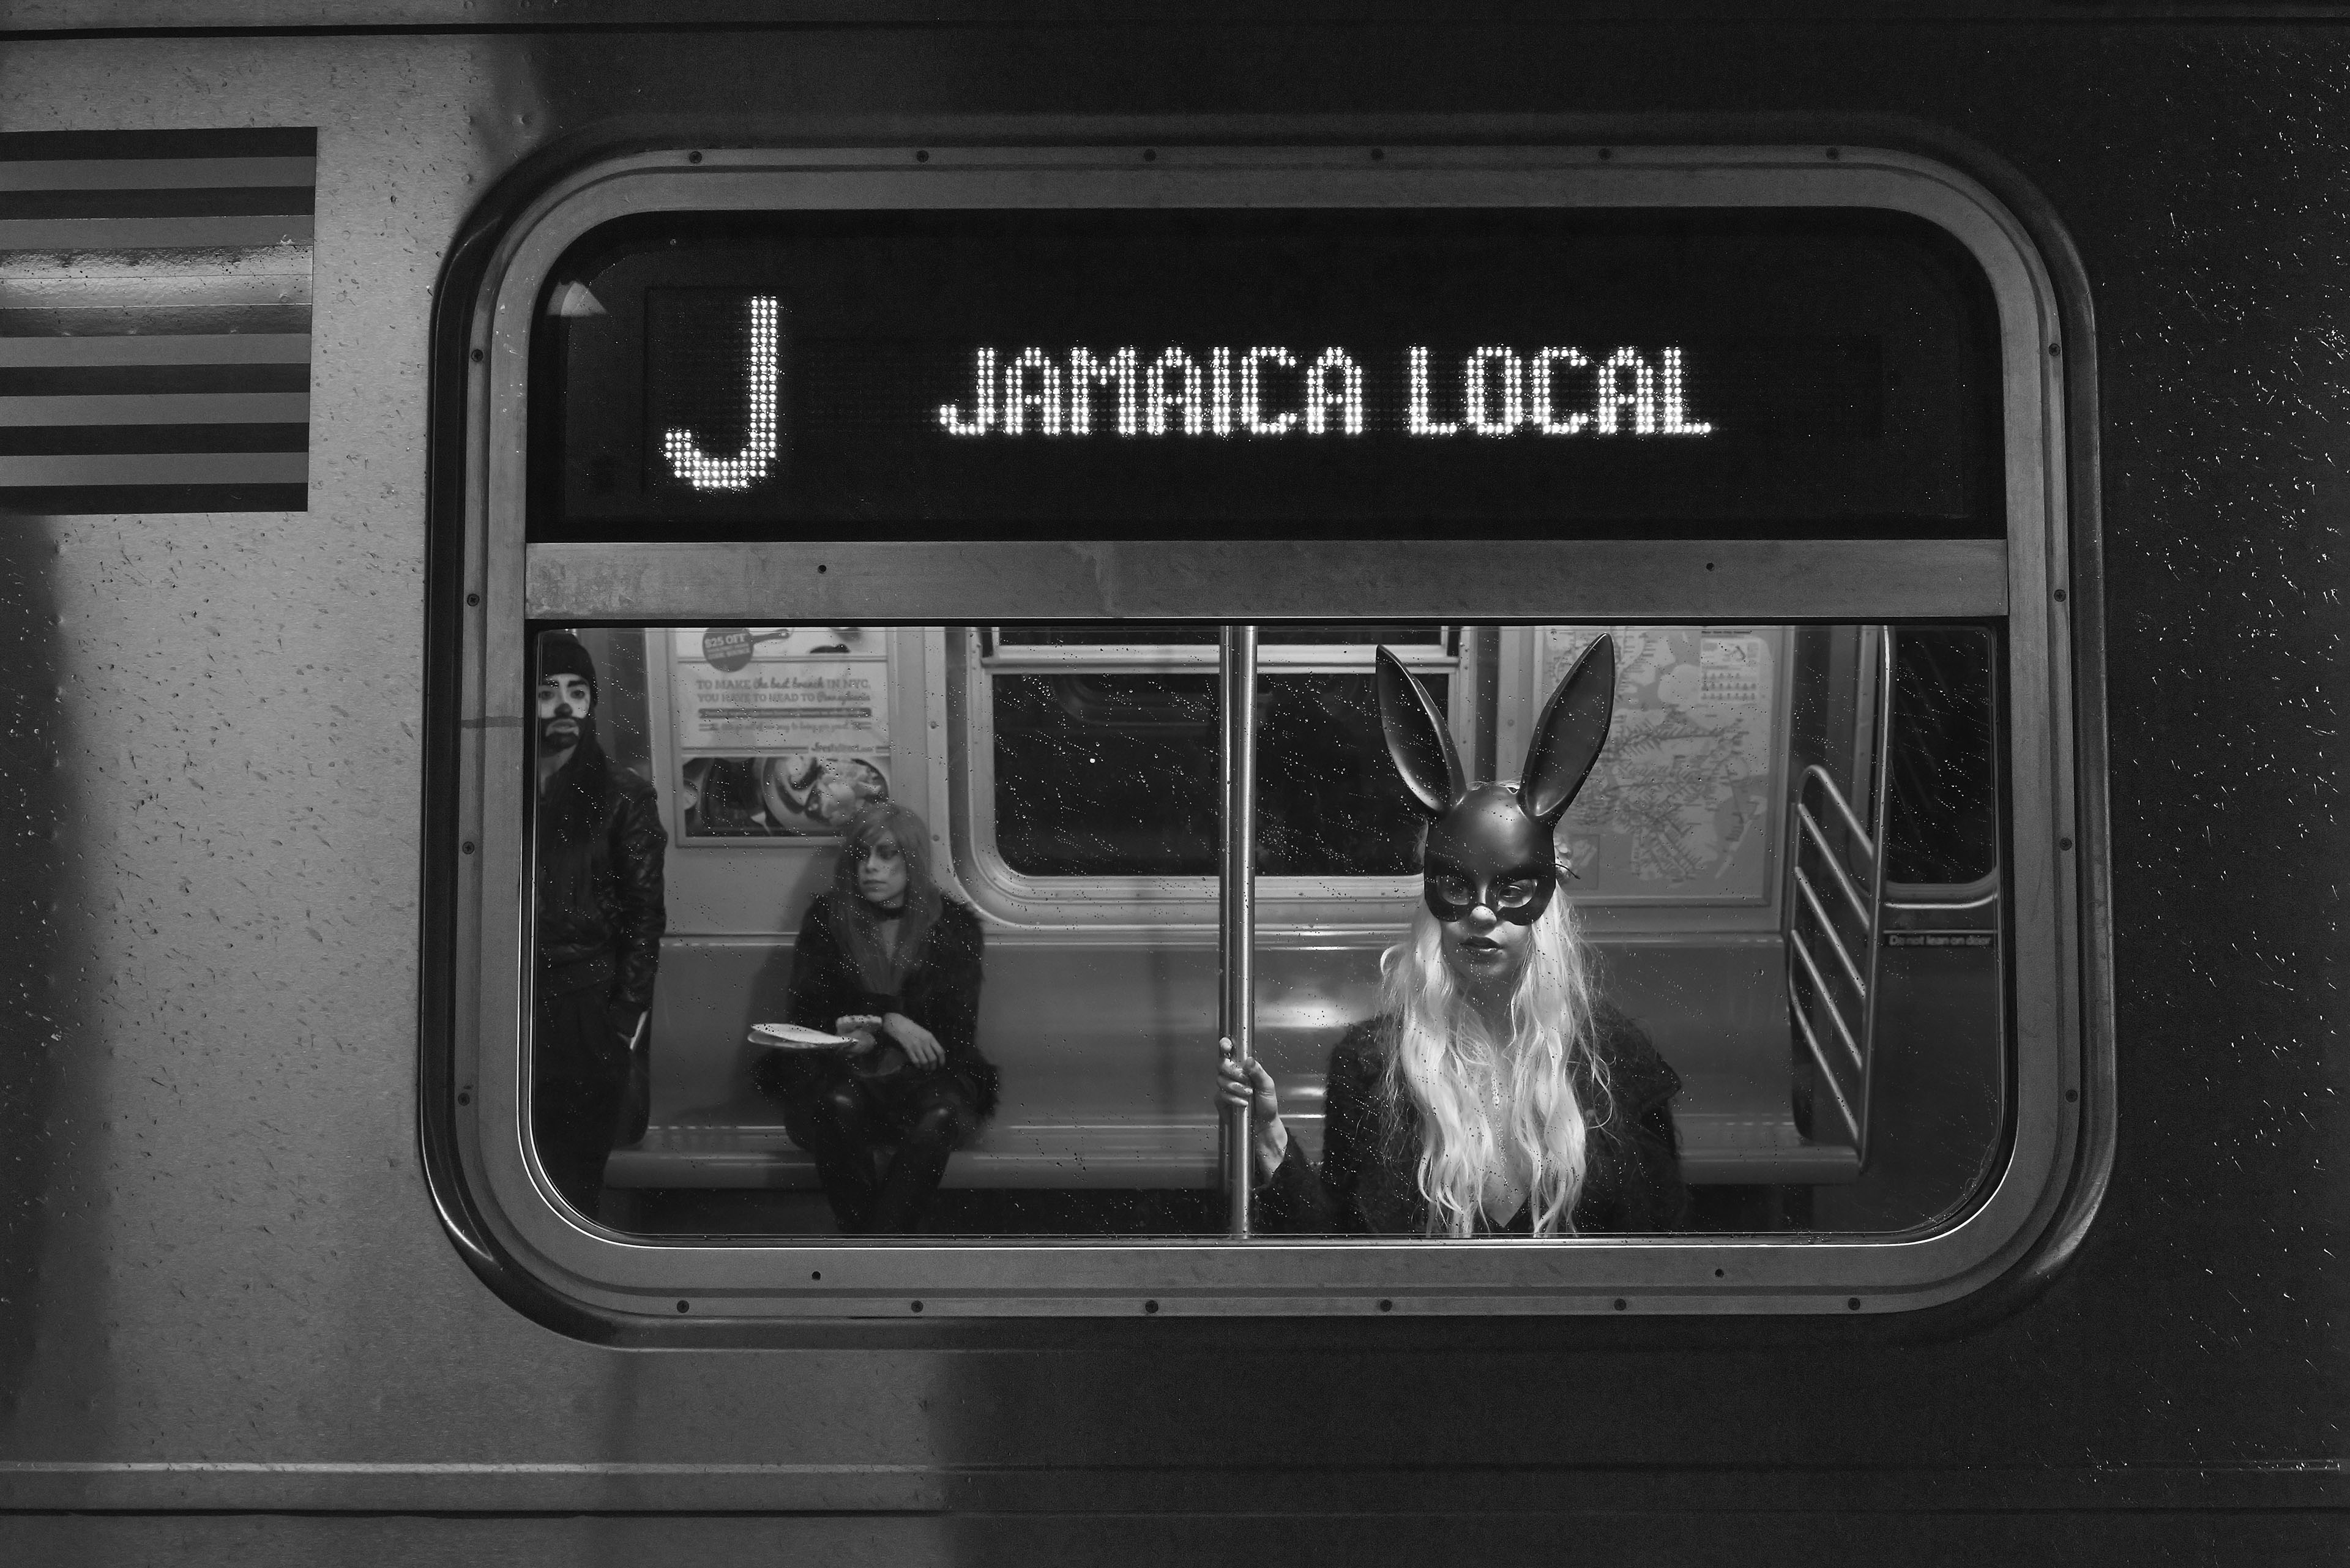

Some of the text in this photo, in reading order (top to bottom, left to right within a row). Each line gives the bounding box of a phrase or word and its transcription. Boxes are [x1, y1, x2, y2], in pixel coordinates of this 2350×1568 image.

[664, 296, 778, 488] J
[939, 346, 1712, 436] JAMAICA LOCAL
[696, 679, 713, 690] TO
[715, 679, 752, 690] MAKE
[753, 676, 769, 689] the
[770, 676, 790, 689] best
[827, 678, 840, 689] IN
[697, 693, 720, 703] YOU
[753, 693, 767, 703] TO
[800, 693, 816, 703] TO
[1889, 935, 1992, 946] Do not lean on door
